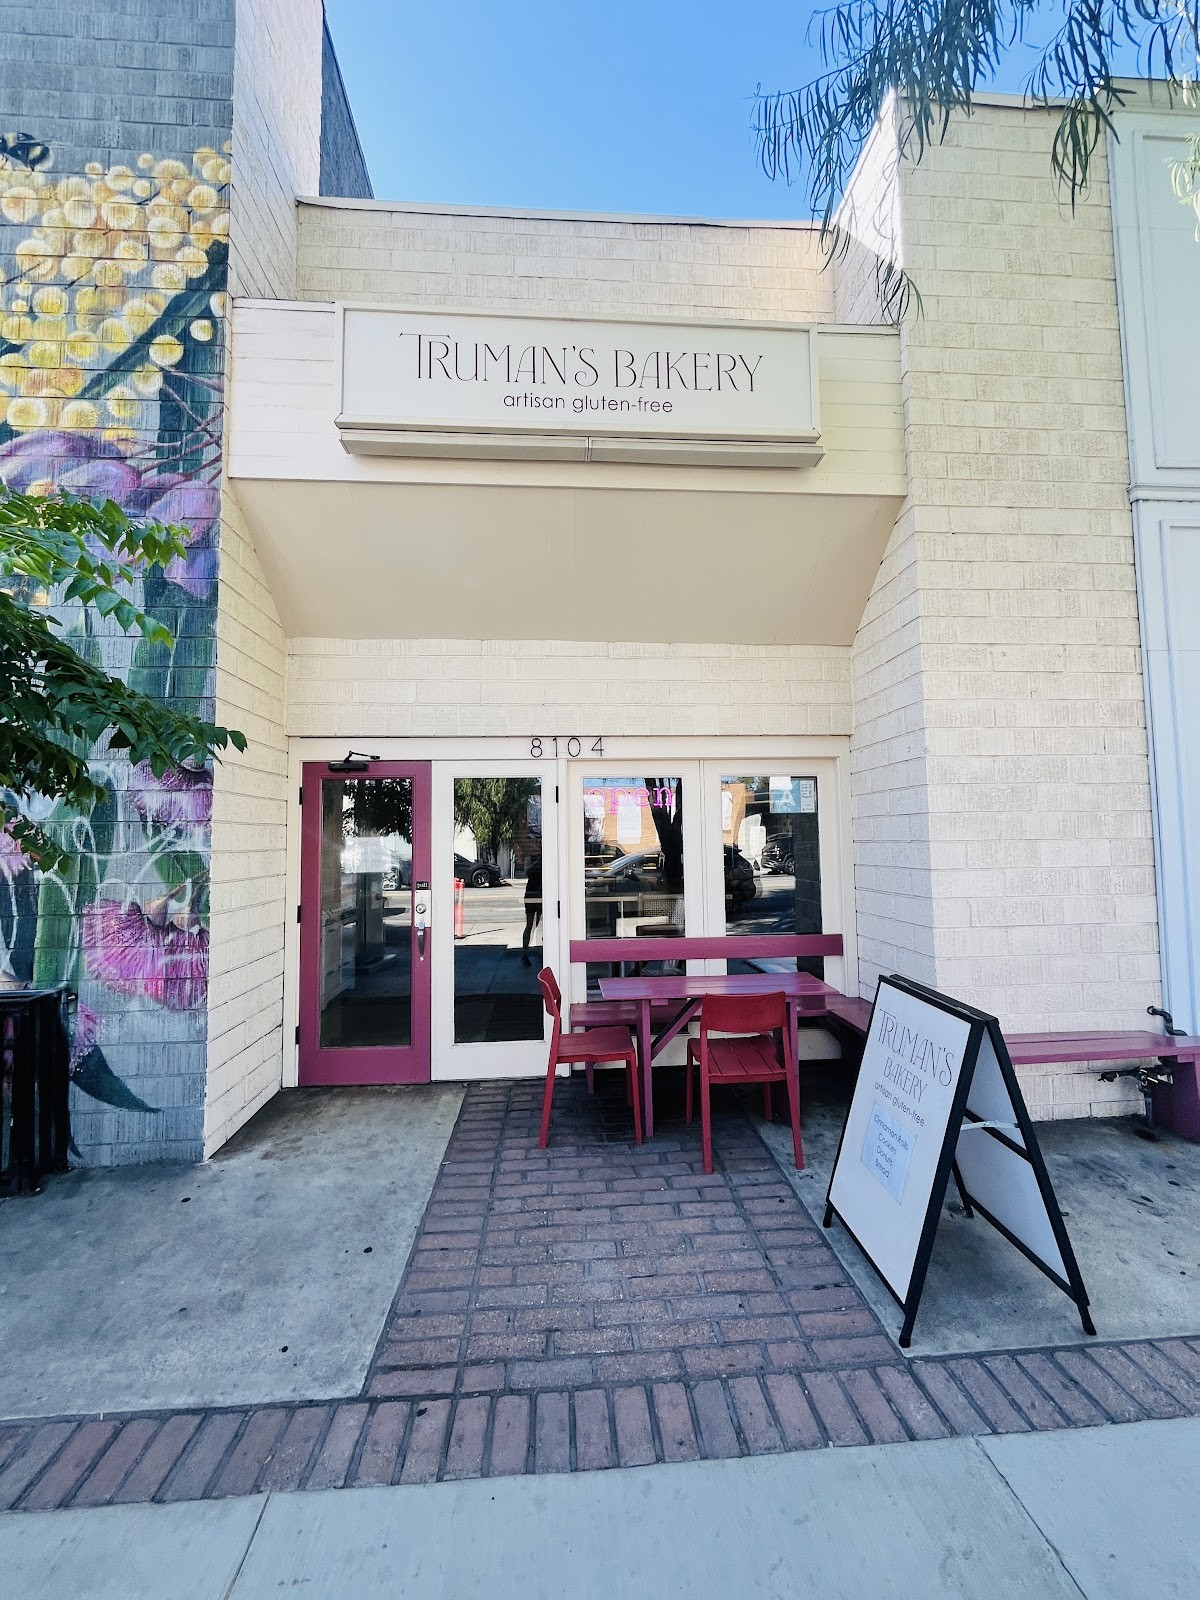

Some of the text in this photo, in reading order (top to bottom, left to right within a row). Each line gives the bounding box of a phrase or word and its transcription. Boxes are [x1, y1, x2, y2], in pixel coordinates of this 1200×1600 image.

[399, 332, 763, 392] TRUMAN'S BAKERY
[503, 394, 673, 413] artisan gluten-free
[530, 736, 604, 758] 8104
[587, 787, 673, 814] open
[878, 1009, 954, 1086] TRUMAN'S
[883, 1057, 928, 1102] BAKERY
[874, 1082, 925, 1127] artisan gluten-free
